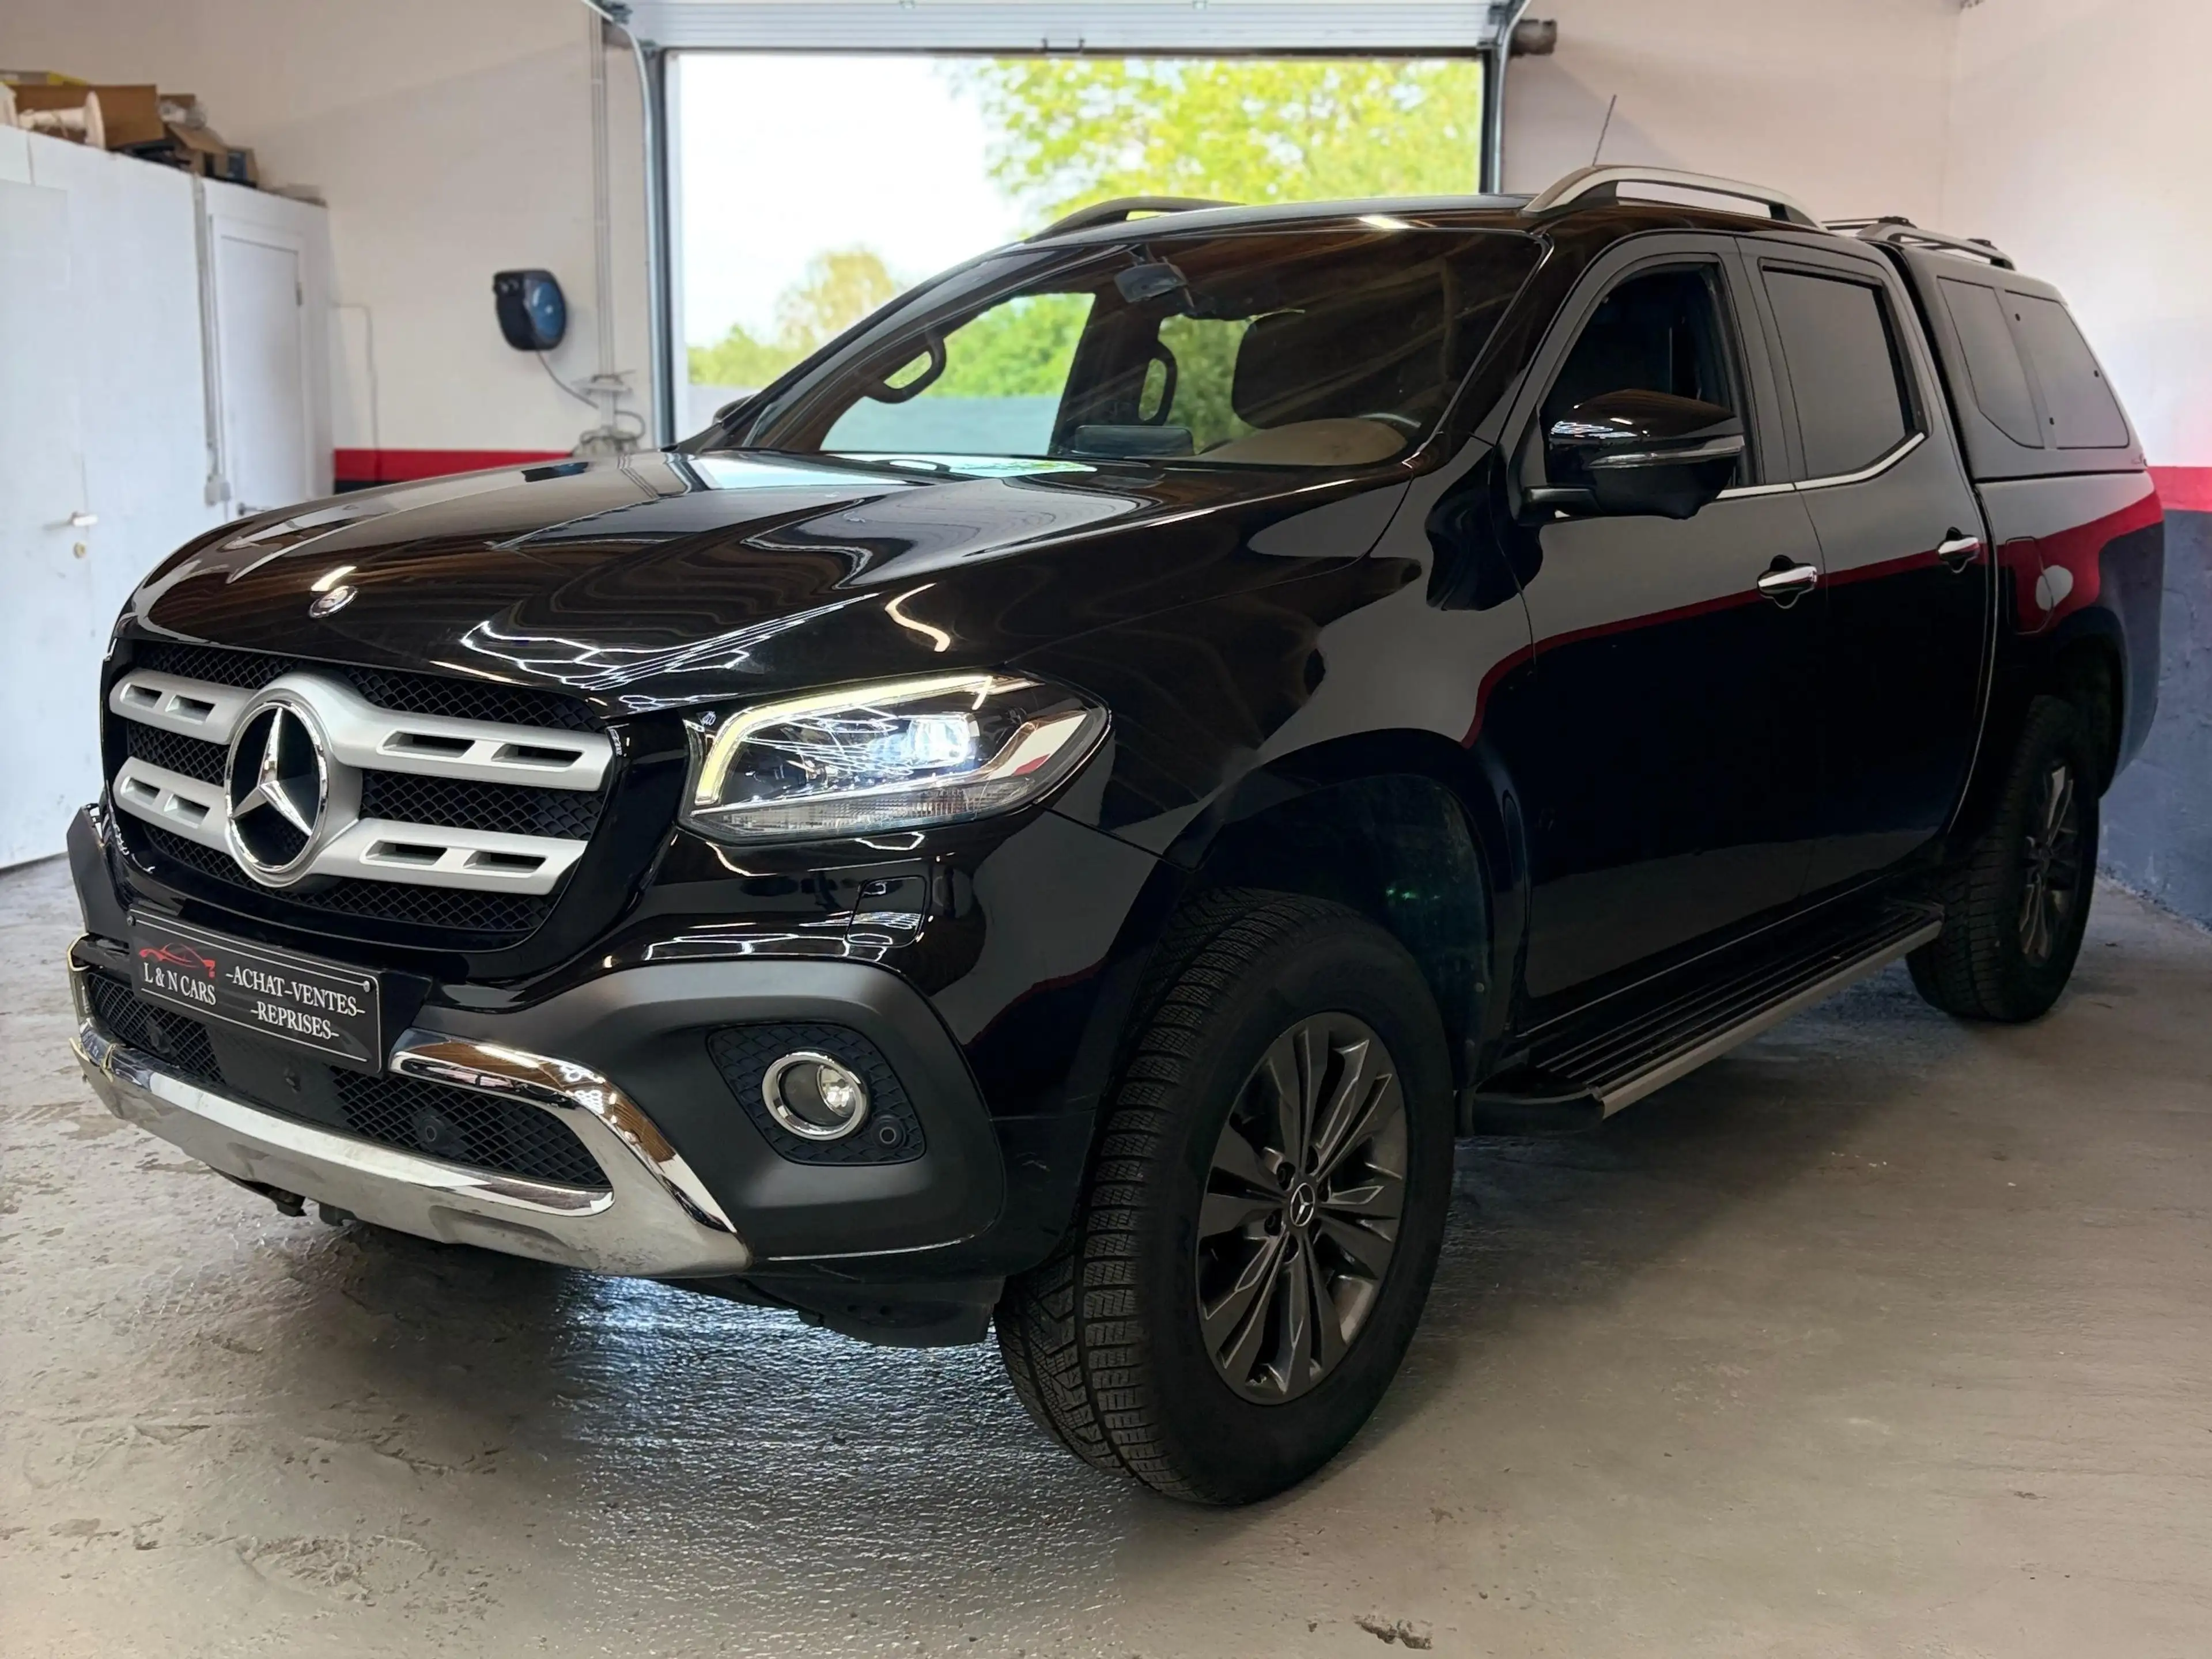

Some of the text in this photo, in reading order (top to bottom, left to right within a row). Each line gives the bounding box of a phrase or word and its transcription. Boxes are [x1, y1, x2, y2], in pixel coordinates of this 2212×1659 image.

[143, 962, 216, 1005] L & N CARS
